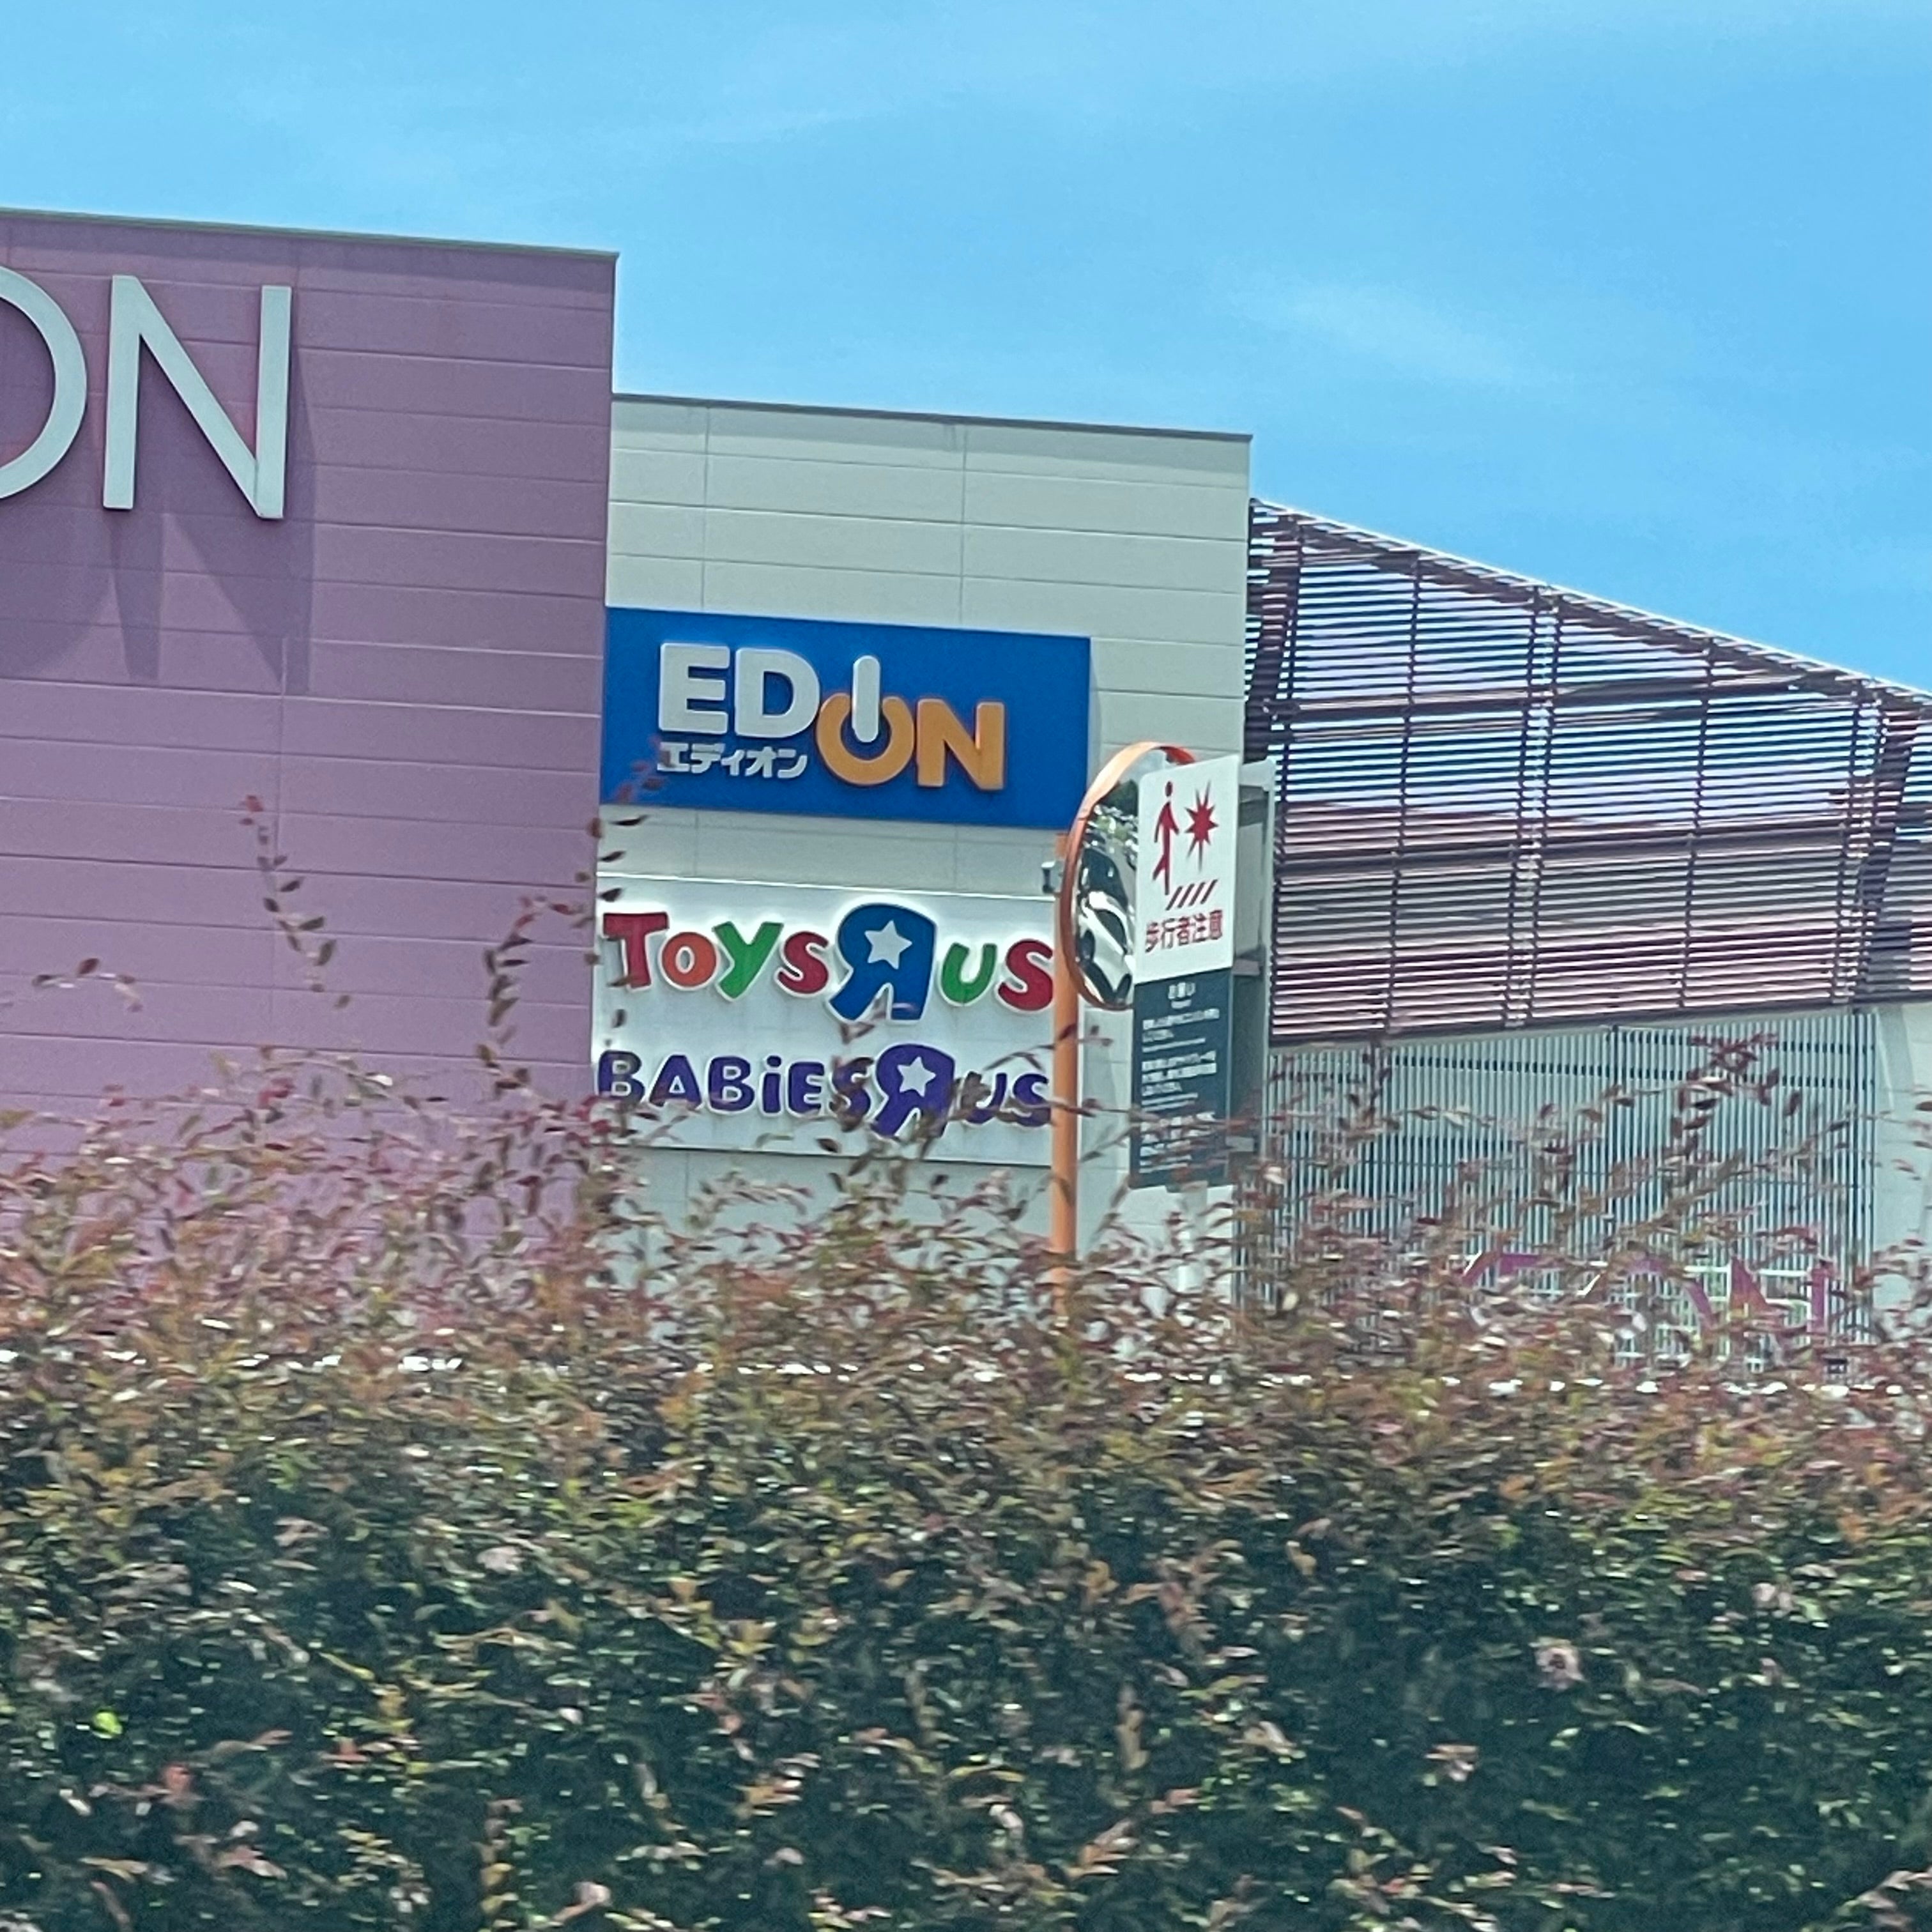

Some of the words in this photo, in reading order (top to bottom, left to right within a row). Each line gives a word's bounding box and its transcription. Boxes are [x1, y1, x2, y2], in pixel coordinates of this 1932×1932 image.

[657, 742, 808, 779] エディオン
[659, 642, 1005, 791] EDION
